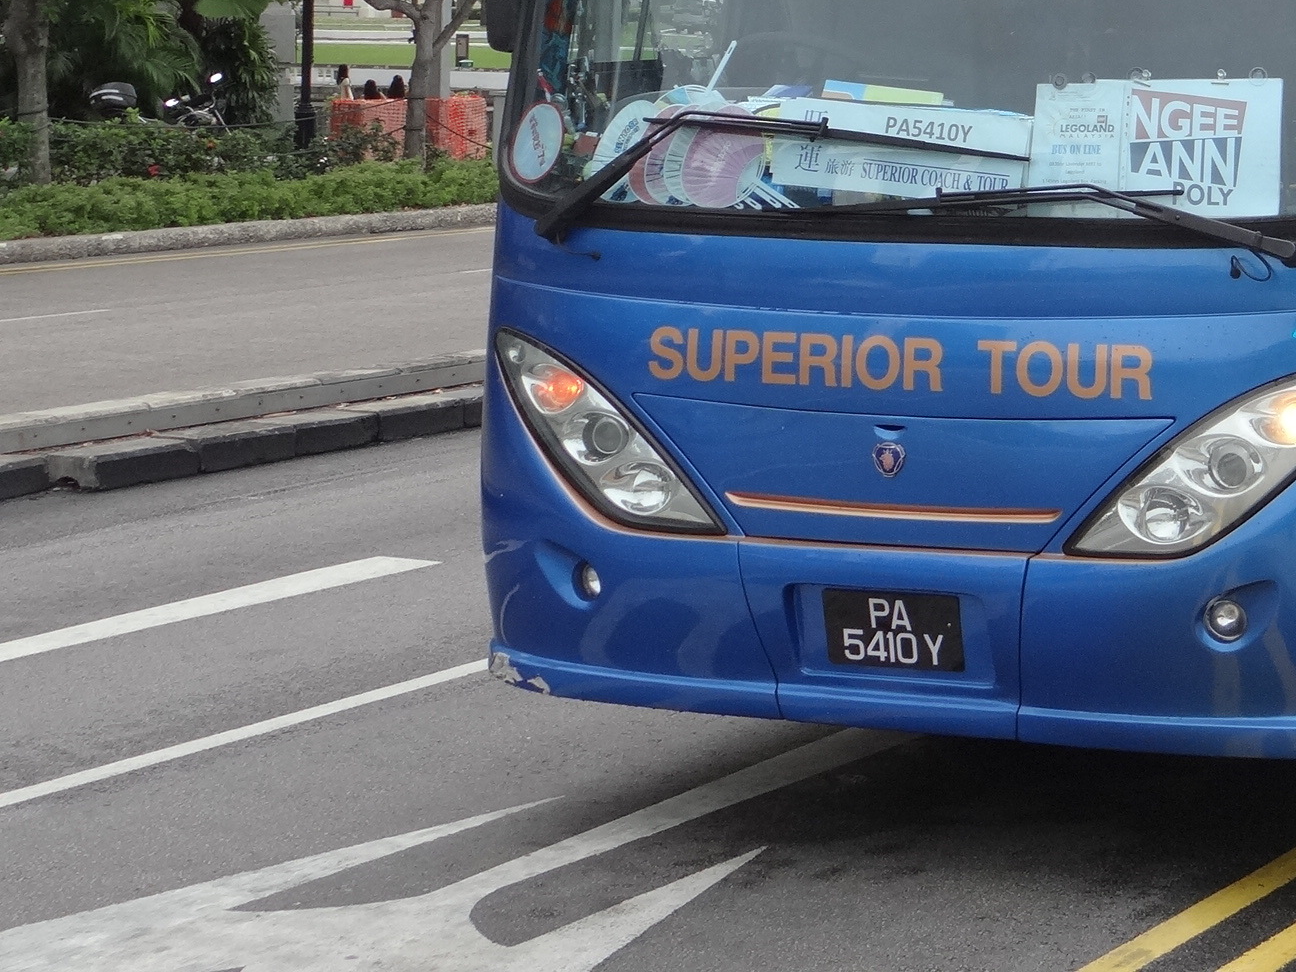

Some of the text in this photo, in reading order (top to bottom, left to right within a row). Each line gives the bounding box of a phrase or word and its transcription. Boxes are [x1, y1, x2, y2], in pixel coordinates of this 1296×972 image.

[884, 116, 973, 143] PA5410Y
[1060, 124, 1115, 133] LEGOLAND
[1132, 93, 1240, 139] NGEE
[1051, 144, 1102, 155] BUS ON LINE
[1137, 137, 1237, 188] ANN
[860, 162, 1009, 191] SUPERIOR COACH & TOUR
[1172, 181, 1234, 206] POLY
[648, 326, 1154, 401] SUPERIOR TOUR
[868, 598, 912, 631] PA
[843, 628, 944, 666] 5410 Y
